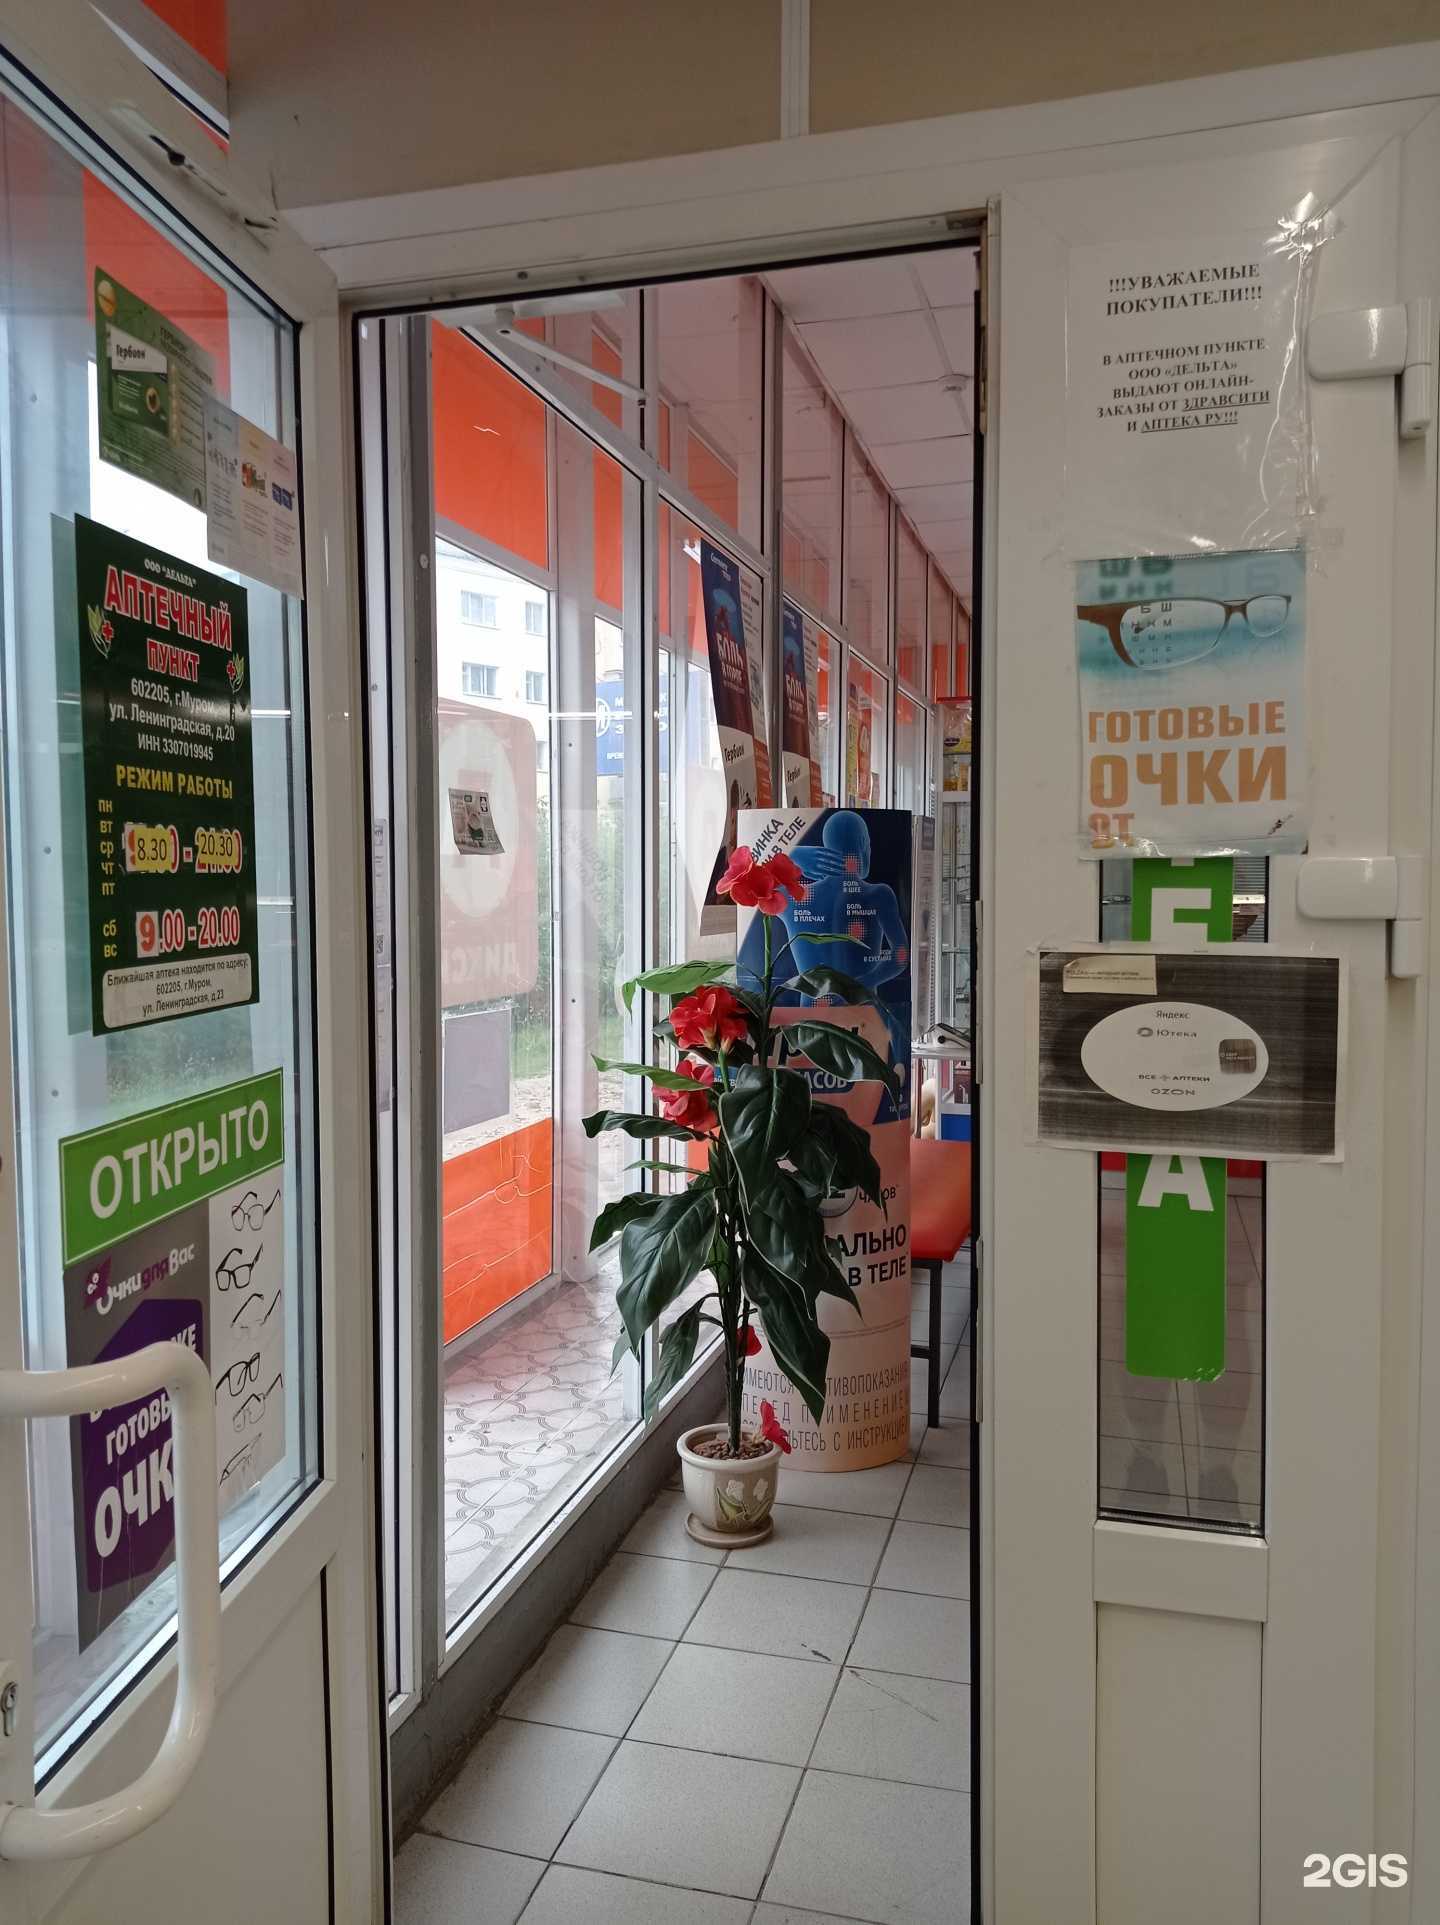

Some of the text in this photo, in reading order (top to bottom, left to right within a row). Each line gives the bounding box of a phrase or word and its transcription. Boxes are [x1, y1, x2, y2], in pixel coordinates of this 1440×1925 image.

[1108, 263, 1260, 293] !!!УВАЖАЕМЫЕ
[1106, 286, 1262, 316] ПОКУПАТЕЛИ!!!
[1103, 338, 1265, 365] В АПТЕЧНОМ ПУНКТЕ
[1128, 361, 1238, 380] ООО «ДЕЛЬТА»
[1097, 391, 1271, 419] ЗАКАЗЫ ОТ ЗДРАВСИТИ
[1113, 382, 1180, 399] ВЫДАЮТ
[1127, 411, 1239, 433] И АПТЕКА РУ!!!
[144, 558, 161, 573] ООО
[104, 564, 232, 652] АПТЕЧНЫЙ
[147, 638, 199, 682] ПУНКТ
[131, 677, 172, 706] 602205,
[109, 702, 236, 742] ул. Ленинградская, д.20
[1088, 700, 1286, 744] ГОТОВЫЕ
[138, 733, 214, 762] ИНН 3307019945
[116, 764, 233, 799] РЕЖИМ РАБОТЫ
[1089, 745, 1288, 808] ОЧКИ
[778, 815, 806, 846] ТЕЛЕ
[137, 838, 167, 861] 8.30
[200, 834, 233, 857] 20.30
[139, 909, 185, 953] 9.00
[198, 906, 240, 949] 20.00
[107, 969, 154, 987] Ближайшая
[155, 967, 181, 980] аптека
[181, 962, 216, 977] находится
[217, 960, 225, 971] по
[1156, 1010, 1191, 1020] Яндекс
[1151, 1088, 1195, 1096] OZON
[89, 1099, 269, 1220] ОТКРЫТО
[848, 1256, 907, 1287] В ТЕЛЕ
[833, 1431, 841, 1452] С
[95, 1438, 174, 1558] ОЧК
